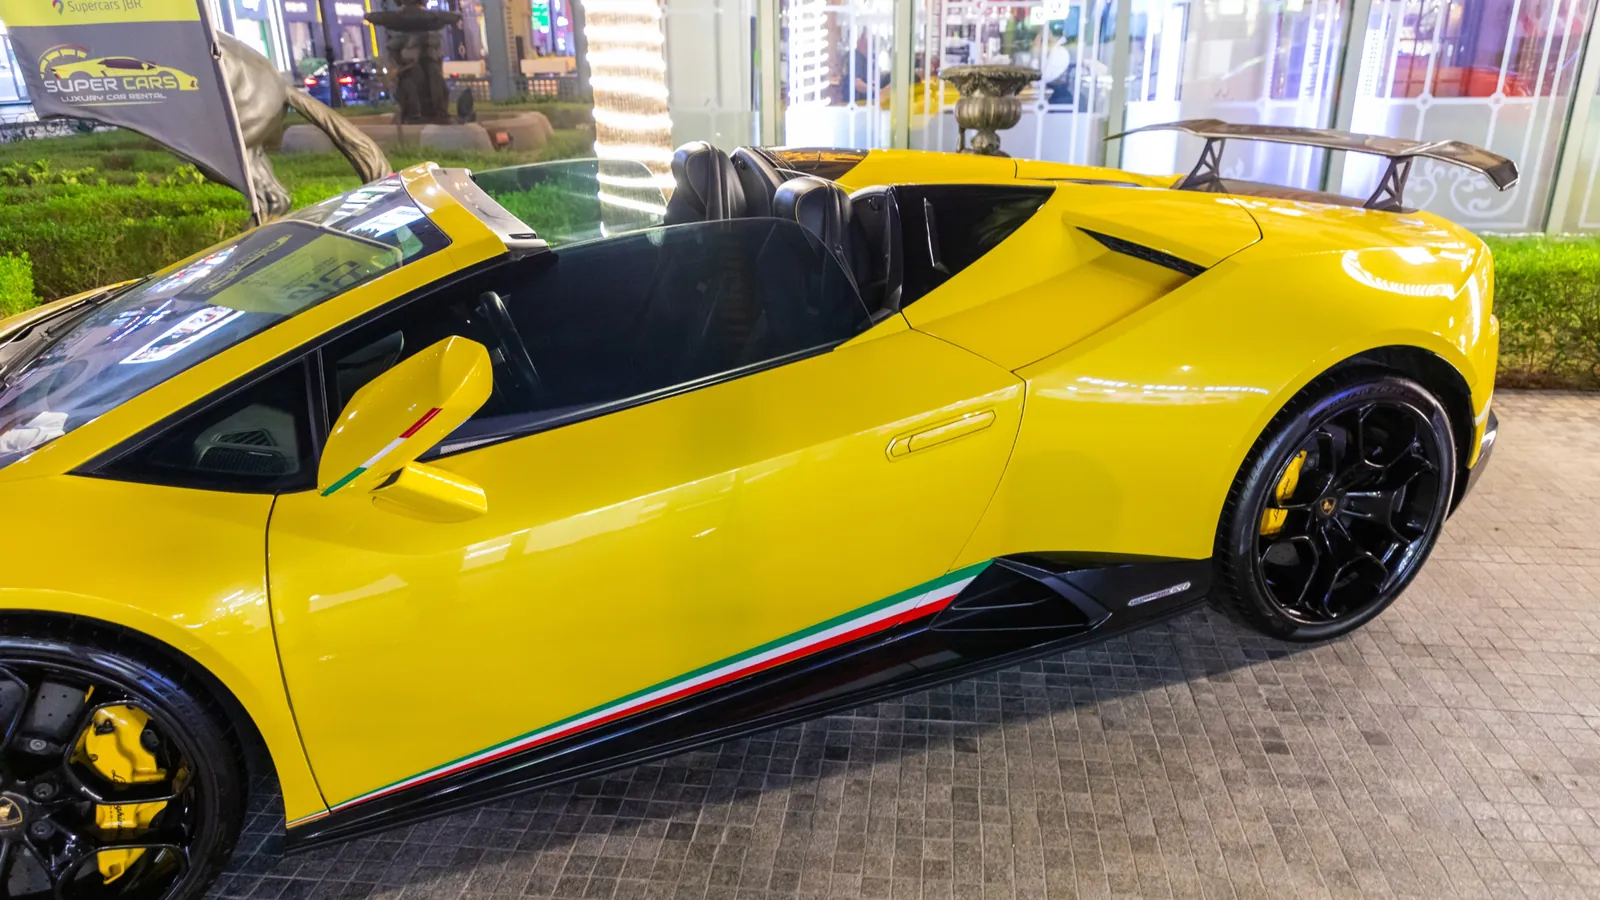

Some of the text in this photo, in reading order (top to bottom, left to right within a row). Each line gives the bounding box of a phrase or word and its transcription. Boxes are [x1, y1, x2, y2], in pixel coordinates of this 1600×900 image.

[67, 1, 120, 14] Supercars
[44, 75, 177, 93] SUPER CARS
